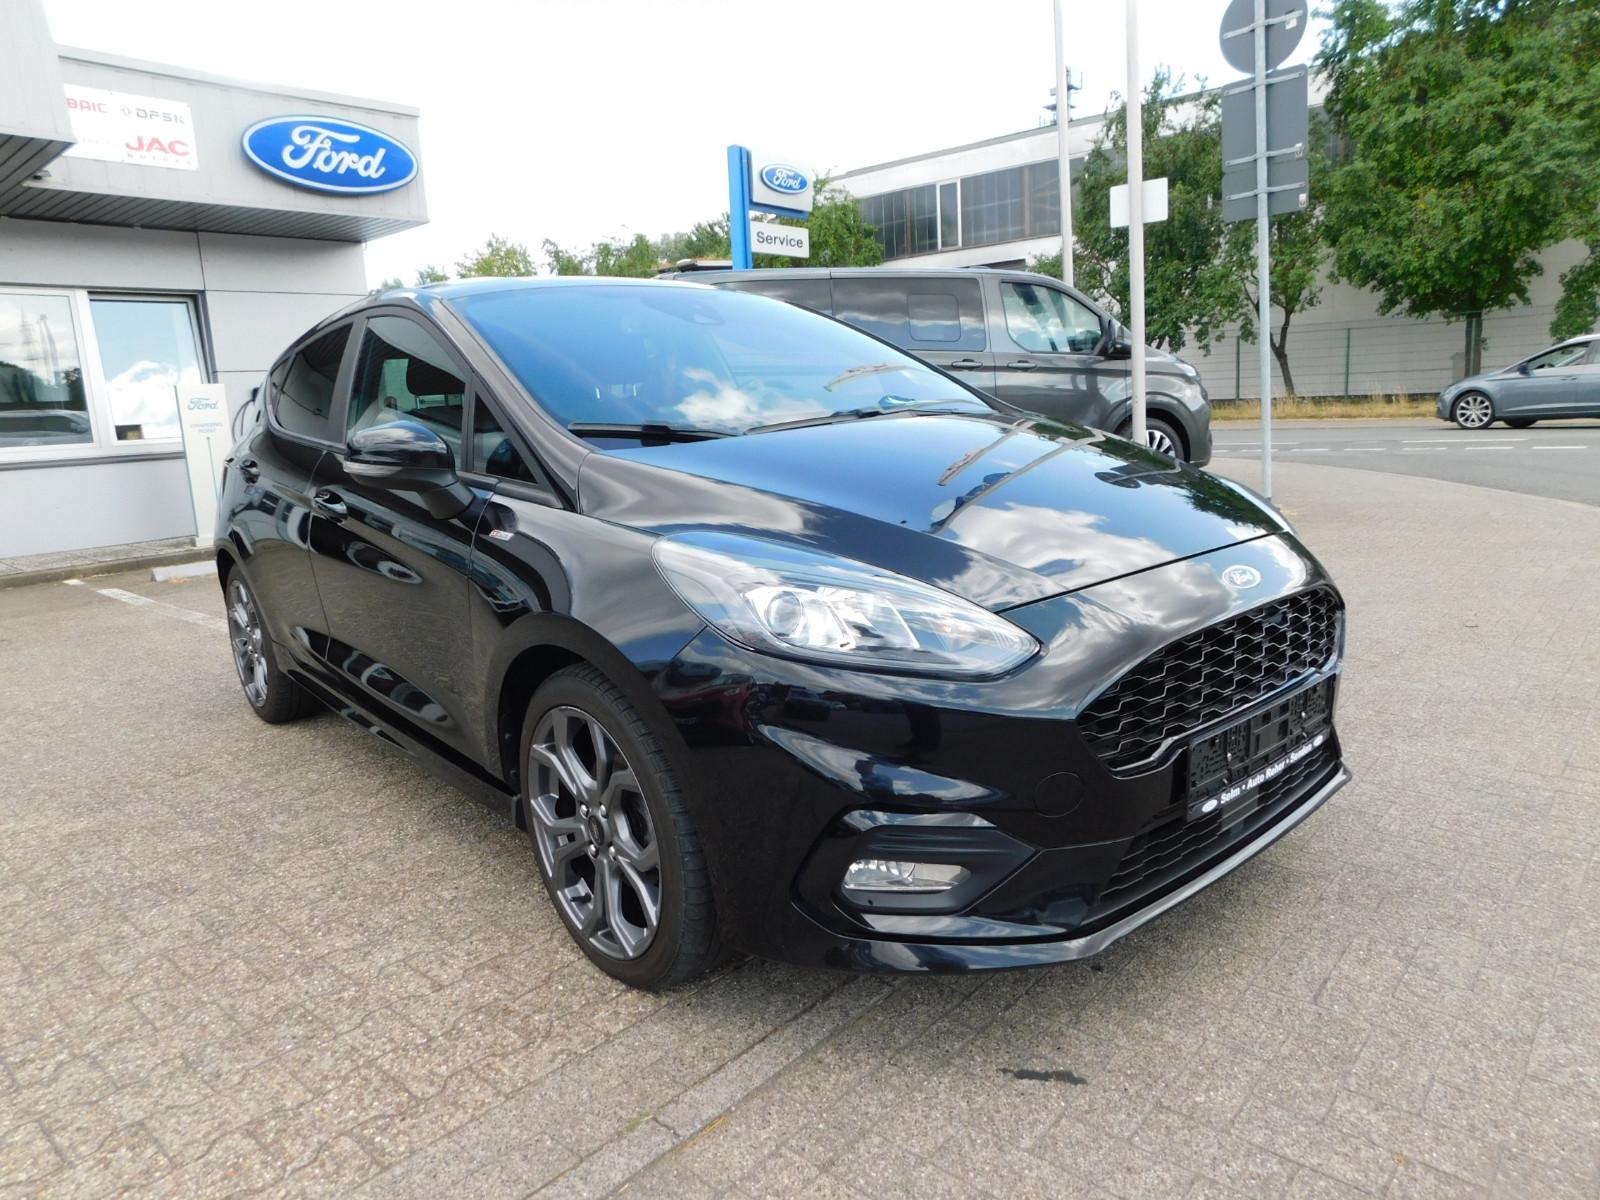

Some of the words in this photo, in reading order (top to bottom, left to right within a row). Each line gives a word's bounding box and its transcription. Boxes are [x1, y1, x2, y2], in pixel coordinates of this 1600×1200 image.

[66, 97, 109, 114] BAIC
[135, 107, 185, 125] DFSK
[125, 135, 191, 157] JAC
[282, 124, 387, 179] Ford
[772, 168, 802, 189] Ford
[756, 230, 804, 248] Service
[187, 397, 218, 410] Ford
[1247, 773, 1265, 790] Auto
